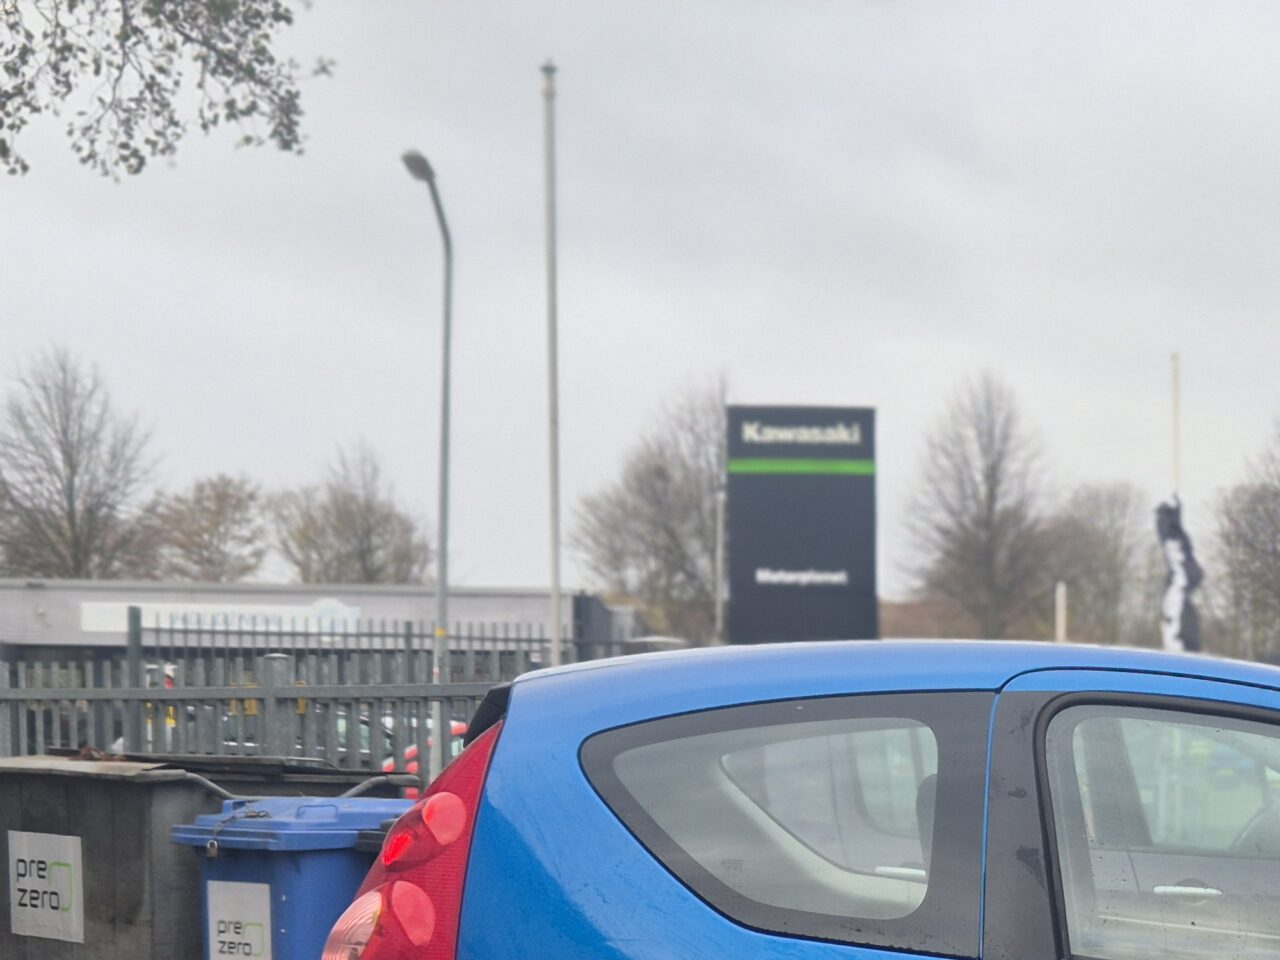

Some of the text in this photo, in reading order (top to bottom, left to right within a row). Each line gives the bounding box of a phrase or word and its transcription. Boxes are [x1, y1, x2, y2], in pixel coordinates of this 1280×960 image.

[742, 421, 861, 444] Kawasaki
[16, 858, 47, 883] pre
[17, 888, 60, 911] zero
[217, 920, 242, 938] pre
[218, 940, 252, 956] zero
